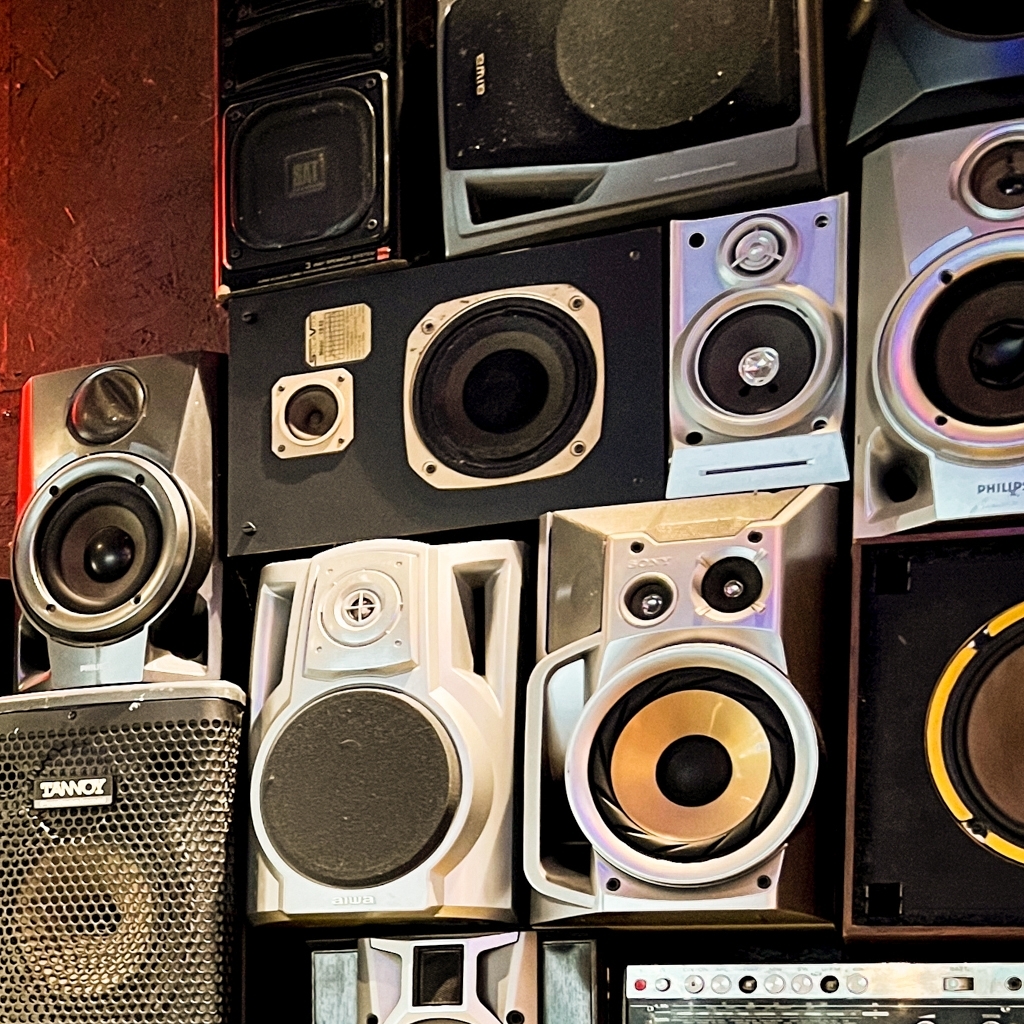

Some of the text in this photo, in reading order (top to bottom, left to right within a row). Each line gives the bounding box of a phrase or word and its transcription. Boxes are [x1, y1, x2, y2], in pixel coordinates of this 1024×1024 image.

[476, 52, 485, 95] aiwa
[627, 556, 672, 569] SONY
[39, 778, 107, 798] TANNOY
[331, 894, 376, 905] aiwa
